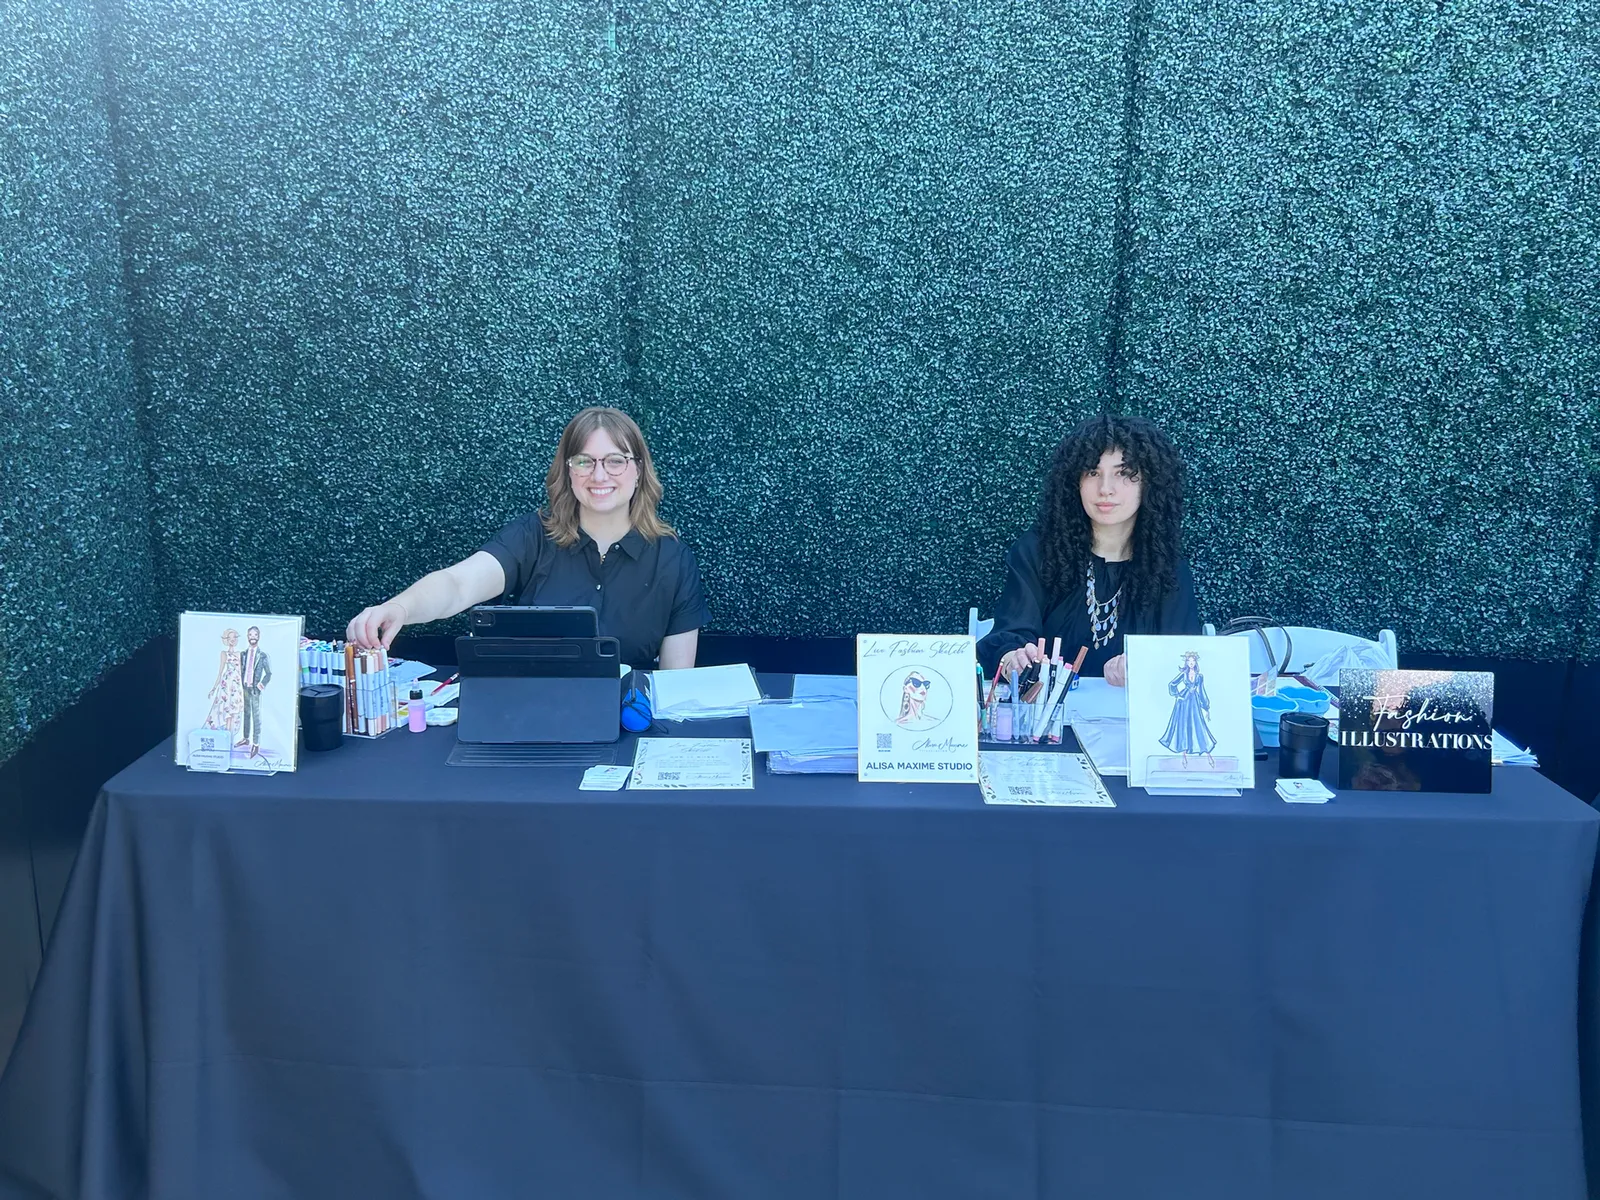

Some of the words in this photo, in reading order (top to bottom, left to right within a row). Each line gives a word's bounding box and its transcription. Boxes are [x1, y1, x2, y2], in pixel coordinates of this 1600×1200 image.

[929, 640, 971, 659] Sketch
[1363, 693, 1472, 732] Fashion
[1340, 730, 1493, 750] ILLUSTRATIONS
[865, 762, 895, 770] ALISA
[897, 762, 935, 771] MAXIME
[937, 762, 973, 771] STUDIO
